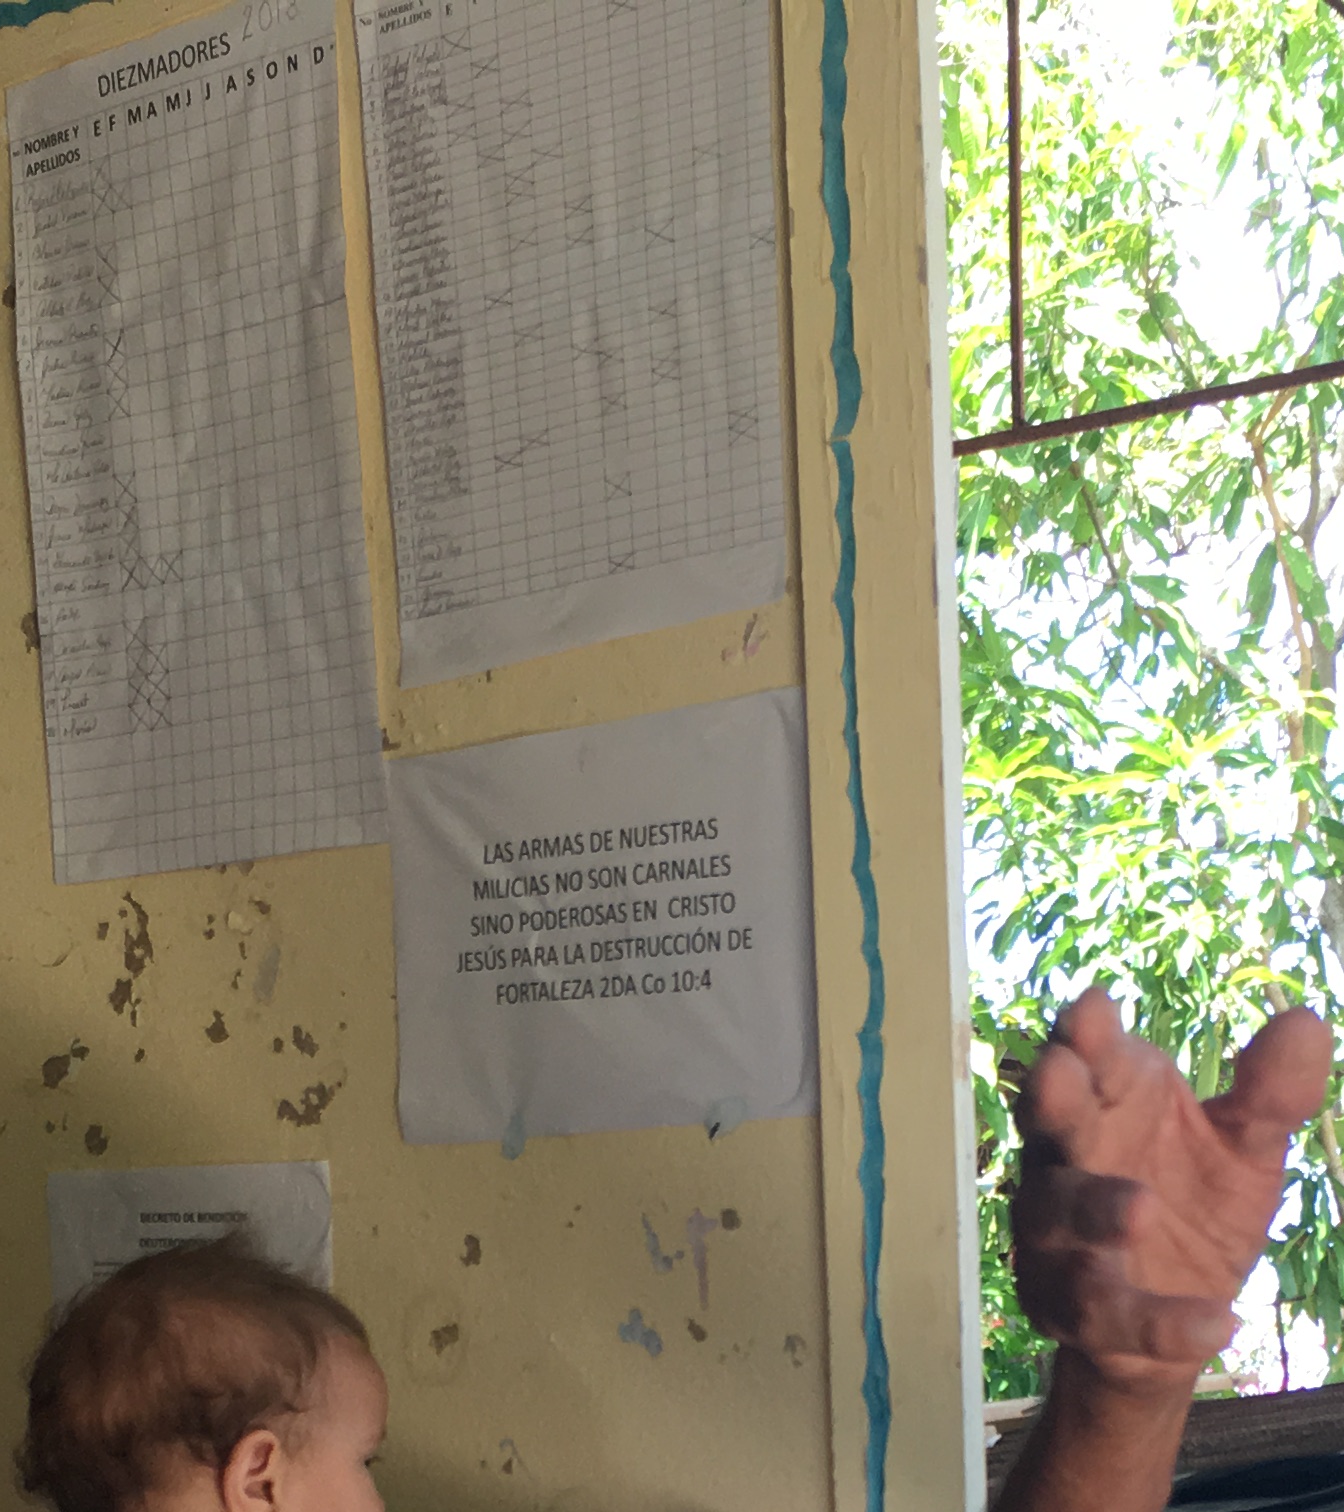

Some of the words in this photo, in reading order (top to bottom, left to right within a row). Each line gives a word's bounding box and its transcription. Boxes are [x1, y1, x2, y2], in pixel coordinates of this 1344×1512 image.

[378, 1, 415, 20] NOMBRE
[379, 9, 432, 35] APELLIDOS
[98, 32, 231, 98] DIEZMADORES
[24, 128, 70, 155] NOMBRE
[72, 125, 79, 139] Y
[93, 119, 102, 137] E
[109, 114, 116, 131] F
[127, 106, 142, 125] M
[147, 101, 158, 119] A
[166, 92, 181, 112] M
[186, 89, 192, 107] J
[205, 82, 211, 100] J
[226, 75, 238, 94] A
[246, 67, 255, 86] S
[266, 61, 278, 79] O
[287, 53, 298, 73] N
[313, 46, 324, 65] D
[26, 148, 81, 178] APELLIDOS
[483, 841, 514, 865] LAS
[518, 832, 584, 861] ARMAS
[589, 830, 613, 853] DE
[620, 817, 719, 850] NUESTRAS
[472, 874, 550, 901] MILICIAS
[555, 870, 583, 894] NO
[588, 866, 627, 890] SON
[632, 854, 732, 886] CARNALES
[470, 912, 514, 937] SINO
[519, 903, 628, 933] PODEROSAS
[632, 899, 657, 922] EN
[668, 892, 736, 919] CRISTO
[456, 944, 507, 973] JESÚS
[511, 945, 559, 968] PARA
[563, 944, 585, 965] LA
[590, 926, 721, 963] DESTRUCCIÓN
[727, 928, 753, 951] DE
[496, 979, 595, 1006] FORTALEZA
[600, 975, 637, 998] 2DA
[641, 973, 665, 995] Co
[671, 969, 712, 993] 10:4
